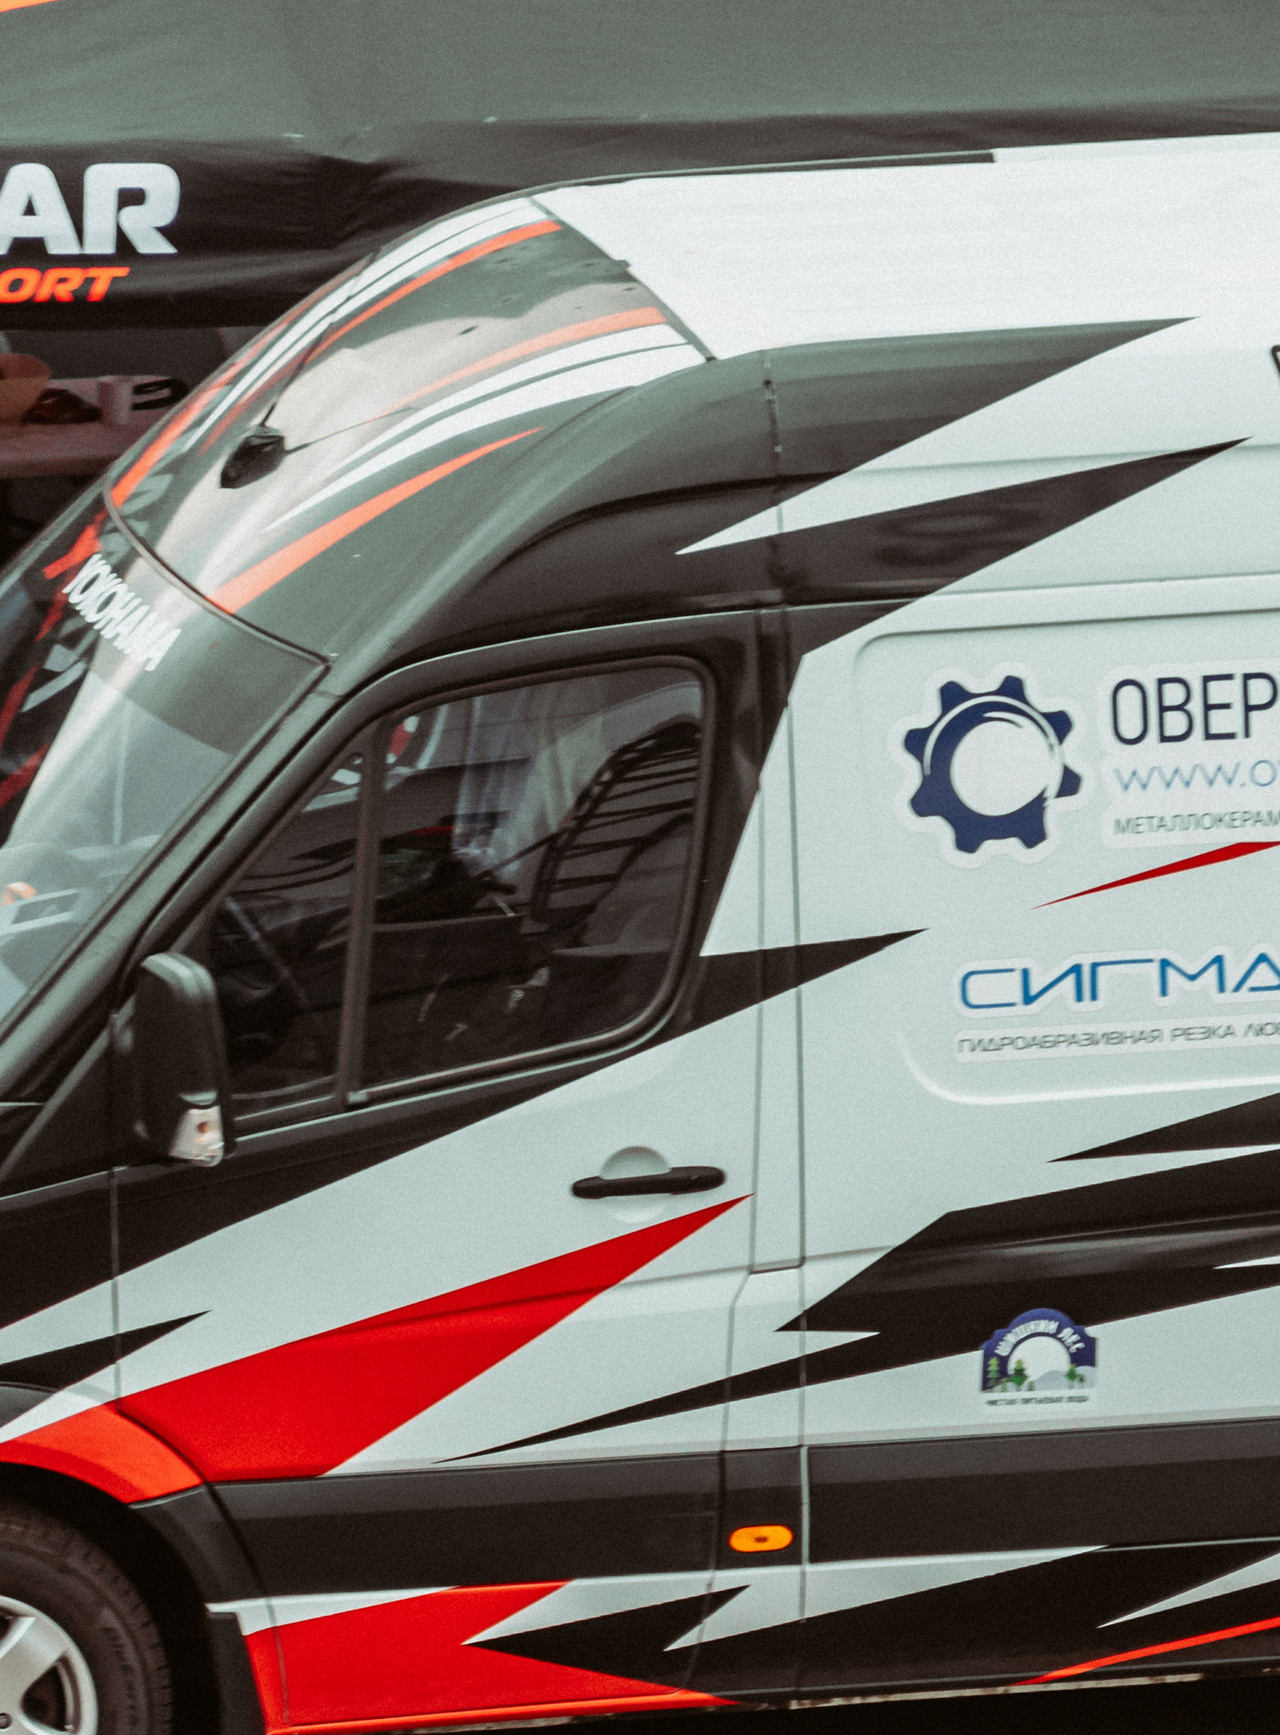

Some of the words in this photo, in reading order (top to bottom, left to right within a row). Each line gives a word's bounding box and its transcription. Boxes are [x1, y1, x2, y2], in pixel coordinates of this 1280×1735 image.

[62, 553, 182, 671] YOKOHAMA
[958, 1028, 1163, 1053] ГИДРОАБРАЗИВНАЯ
[1169, 1024, 1236, 1044] РЕЗКА
